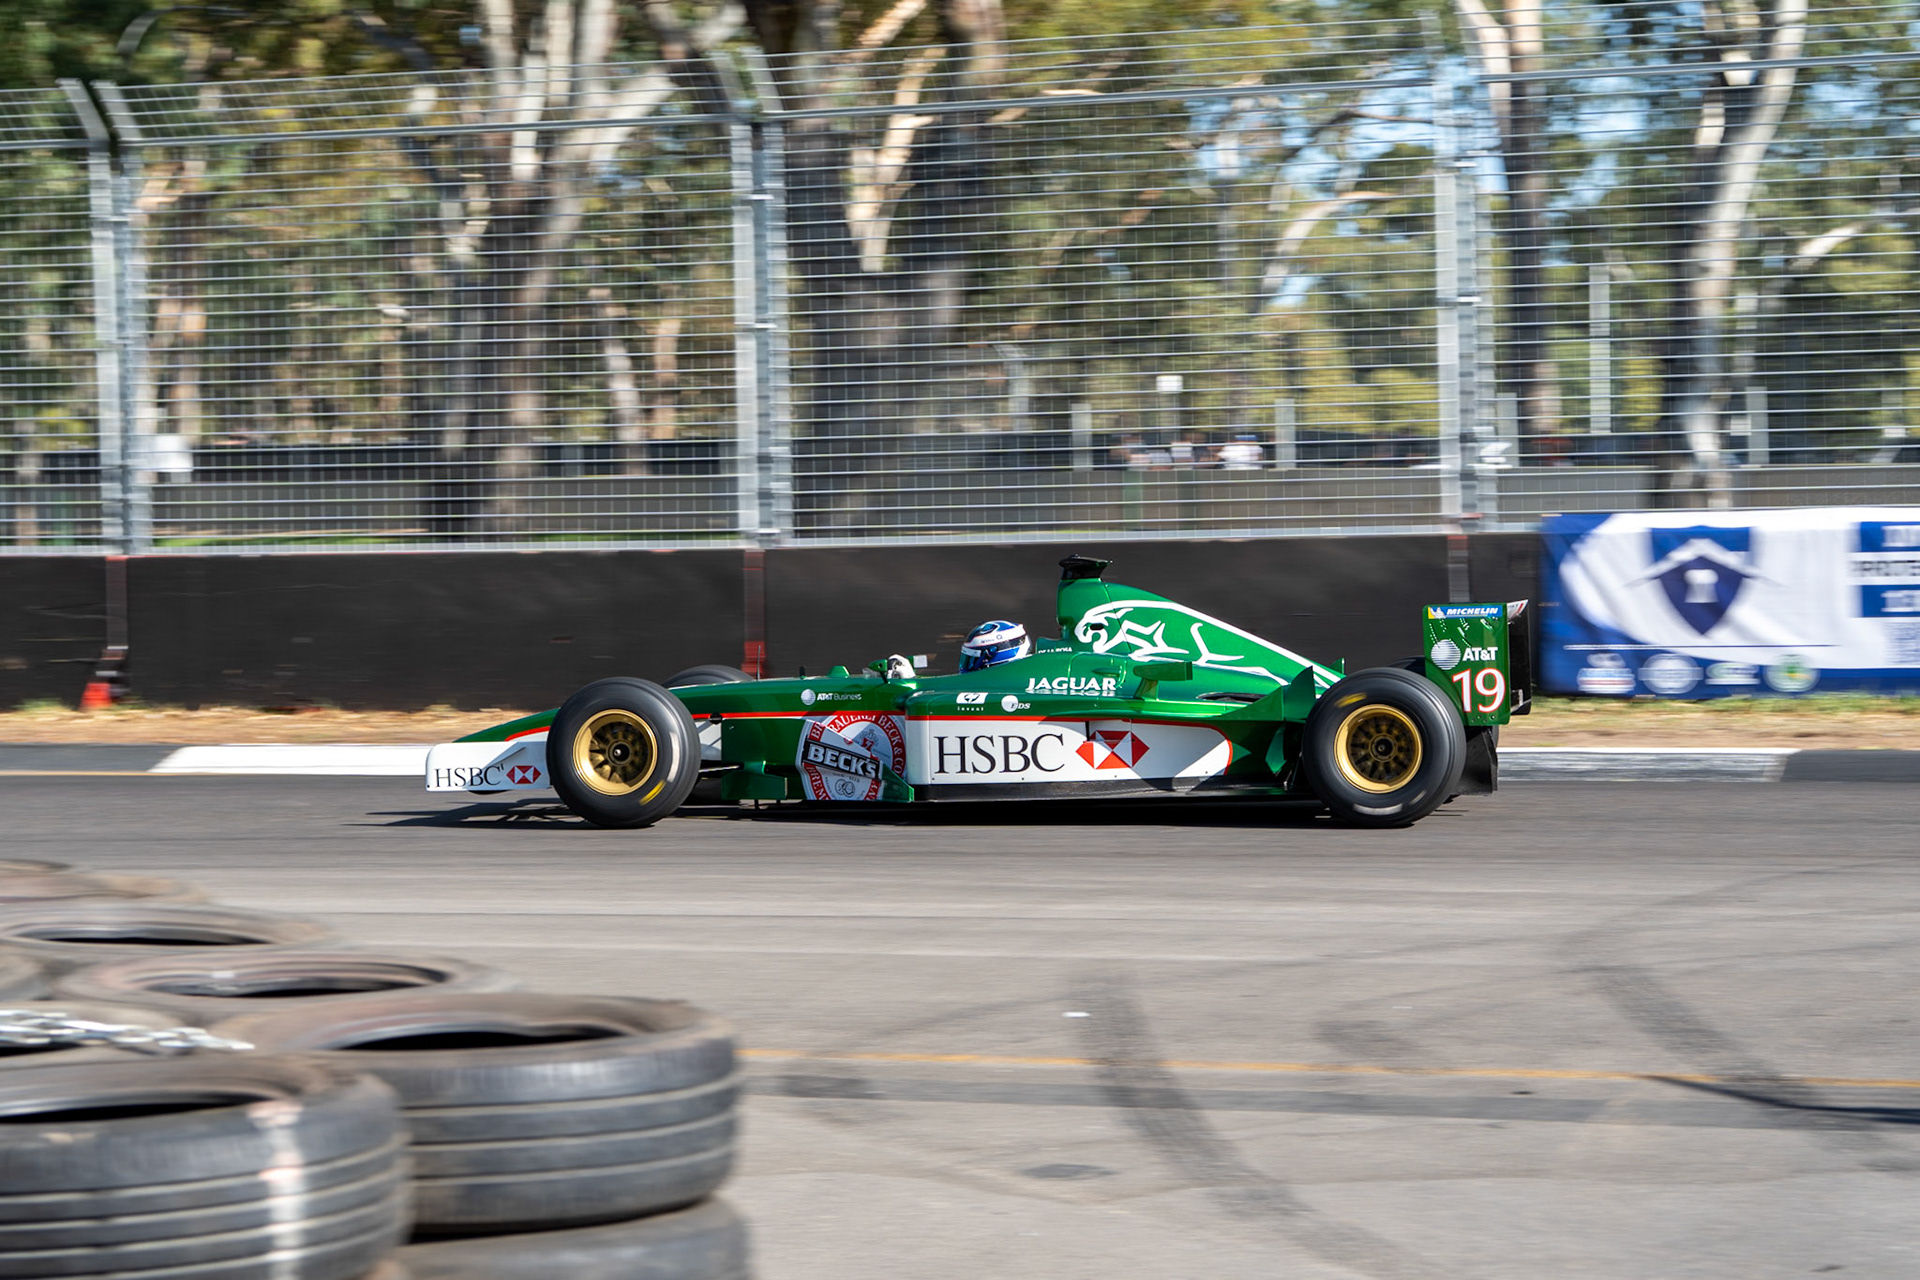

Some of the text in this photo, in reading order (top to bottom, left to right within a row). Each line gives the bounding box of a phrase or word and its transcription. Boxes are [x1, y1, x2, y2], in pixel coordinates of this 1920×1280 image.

[1446, 607, 1499, 616] MICHELIN
[1462, 646, 1498, 661] AT&T
[1025, 677, 1116, 691] JAGUAR
[1452, 667, 1506, 713] 19
[816, 693, 833, 701] AT&T
[1010, 702, 1031, 710] EDS
[878, 715, 902, 746] BECK
[807, 743, 877, 779] BECK'S
[933, 733, 1065, 774] HSBC
[434, 764, 504, 788] HSBC
